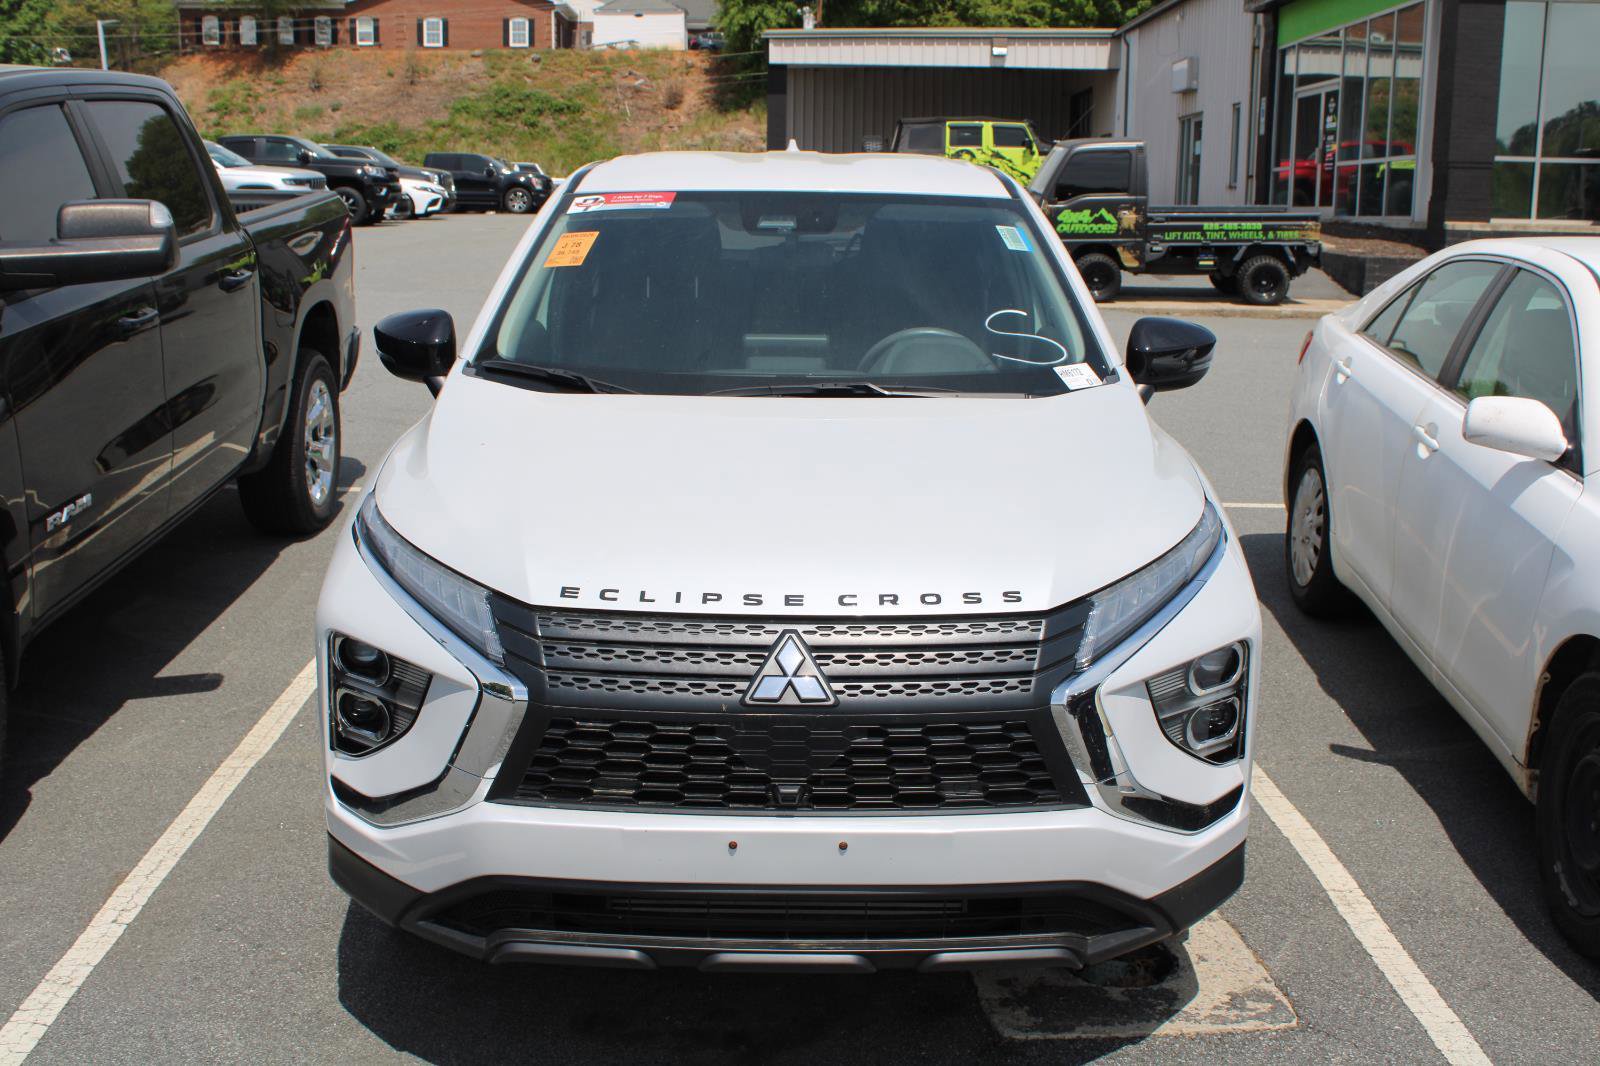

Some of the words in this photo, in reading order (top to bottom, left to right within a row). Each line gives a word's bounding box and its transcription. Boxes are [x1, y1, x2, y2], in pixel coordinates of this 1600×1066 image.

[1056, 223, 1118, 234] OUTDOORS
[1164, 231, 1182, 240] LIFT
[1183, 231, 1204, 241] KITS,
[1206, 231, 1227, 240] TINT,
[1228, 230, 1266, 240] WHEELS,
[1268, 232, 1274, 240] &
[46, 493, 92, 532] RAM
[560, 586, 804, 606] ECLIPSE
[838, 590, 1022, 606] CROSS
